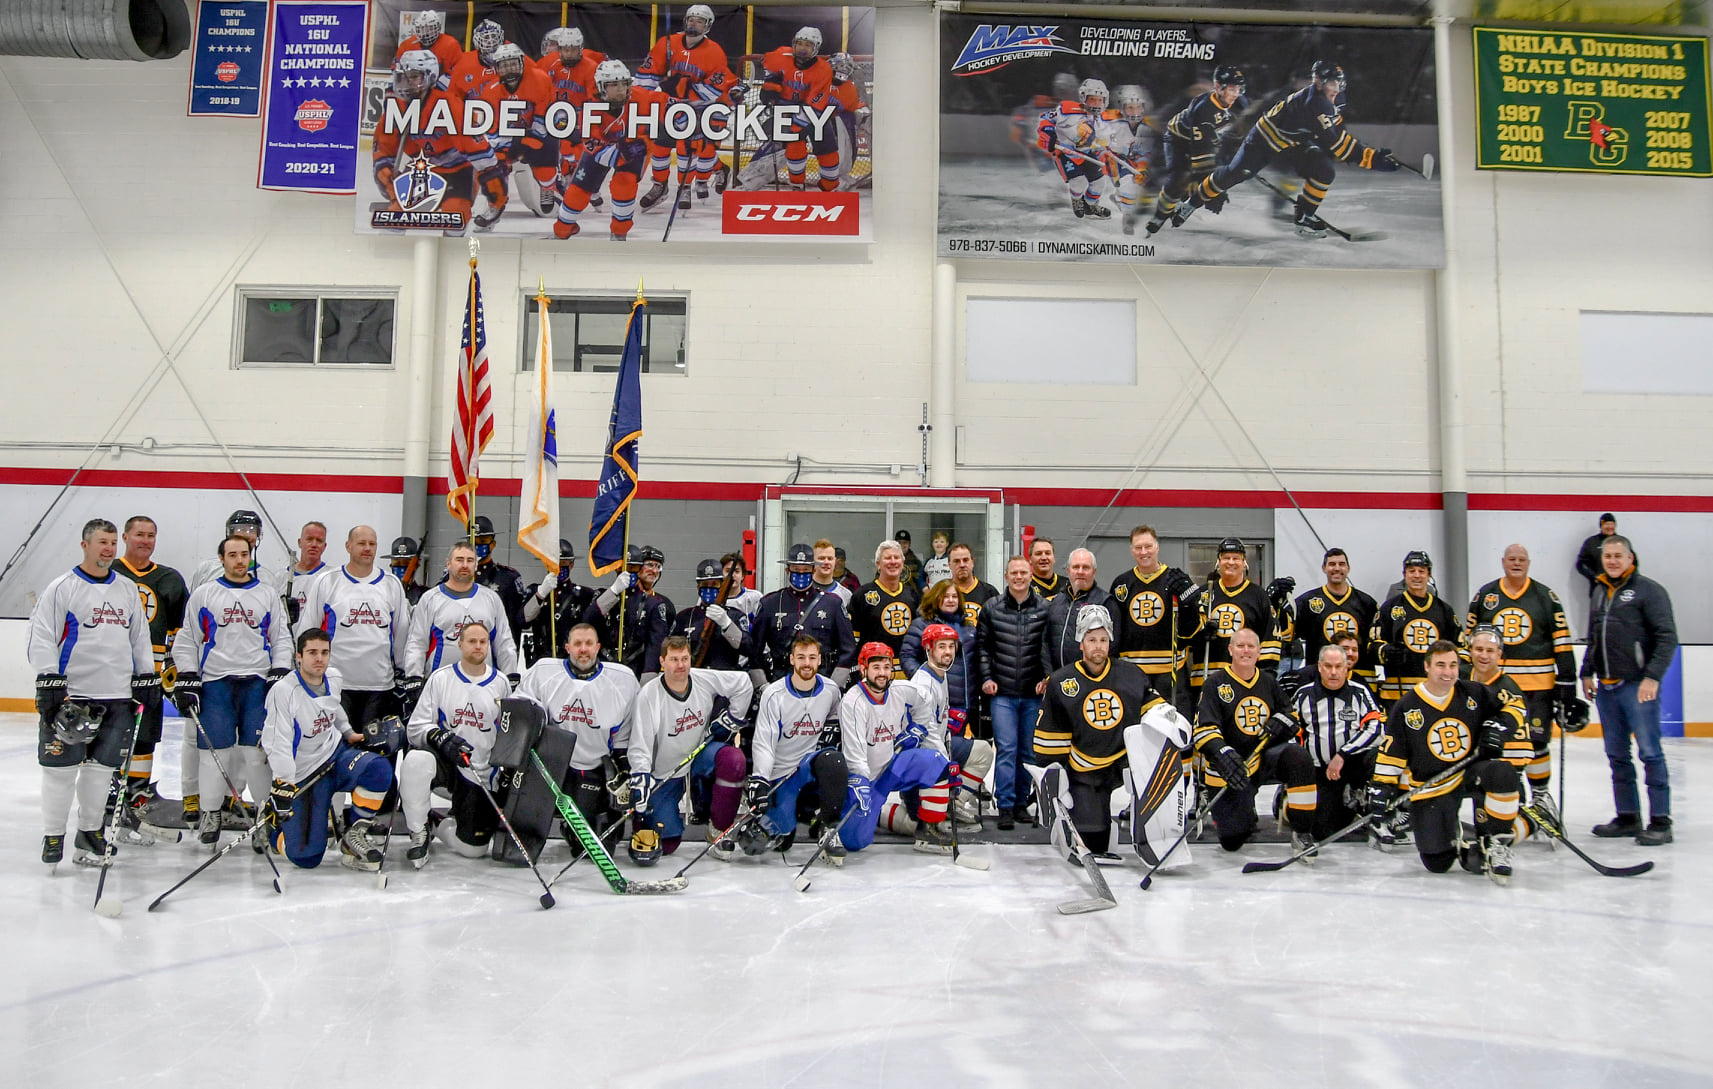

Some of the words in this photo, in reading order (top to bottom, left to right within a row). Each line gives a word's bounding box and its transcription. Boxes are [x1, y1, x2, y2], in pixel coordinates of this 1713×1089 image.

[220, 9, 246, 17] USPHL
[300, 15, 340, 26] USPHL
[208, 28, 255, 36] CHAMPIONS
[225, 19, 240, 27] 16U
[307, 29, 330, 40] 16U
[1080, 26, 1141, 40] DEVELOPING
[285, 43, 350, 55] NATIONAL
[952, 24, 1064, 70] MAX
[1080, 40, 1150, 57] BUILDING
[1154, 42, 1215, 60] DREAMS
[1497, 34, 1578, 56] NHIAA
[1671, 43, 1685, 60] 1
[280, 58, 354, 70] CHAMPIONS
[968, 56, 1001, 71] HOCKEY
[1002, 50, 1053, 62] DEVELOPMENT
[209, 97, 240, 105] 2018-19
[384, 99, 527, 137] MADE
[544, 101, 610, 138] OF
[627, 102, 836, 141] HOCKEY
[1497, 104, 1542, 122] 1987
[1645, 111, 1692, 130] 2007
[1497, 124, 1545, 142] 2000
[1645, 130, 1693, 149] 2008
[1499, 144, 1544, 163] 2001
[1646, 151, 1694, 169] 2015
[285, 162, 335, 174] 2020-21
[375, 211, 462, 224] ISLANDERS
[736, 204, 845, 222] CCM
[949, 239, 1027, 253] 978-837-5066
[1038, 241, 1155, 257] DYNAMICSKATING.COM
[375, 609, 381, 617] 3
[1140, 600, 1154, 617] B
[890, 610, 905, 628] B
[1220, 611, 1235, 629] B
[1502, 614, 1520, 636] B
[1413, 626, 1430, 645] B
[478, 711, 484, 720] 3
[562, 704, 585, 713] Skate
[587, 707, 593, 716] 3
[1094, 698, 1112, 720] B
[1244, 705, 1260, 727] B
[1438, 725, 1462, 755] B
